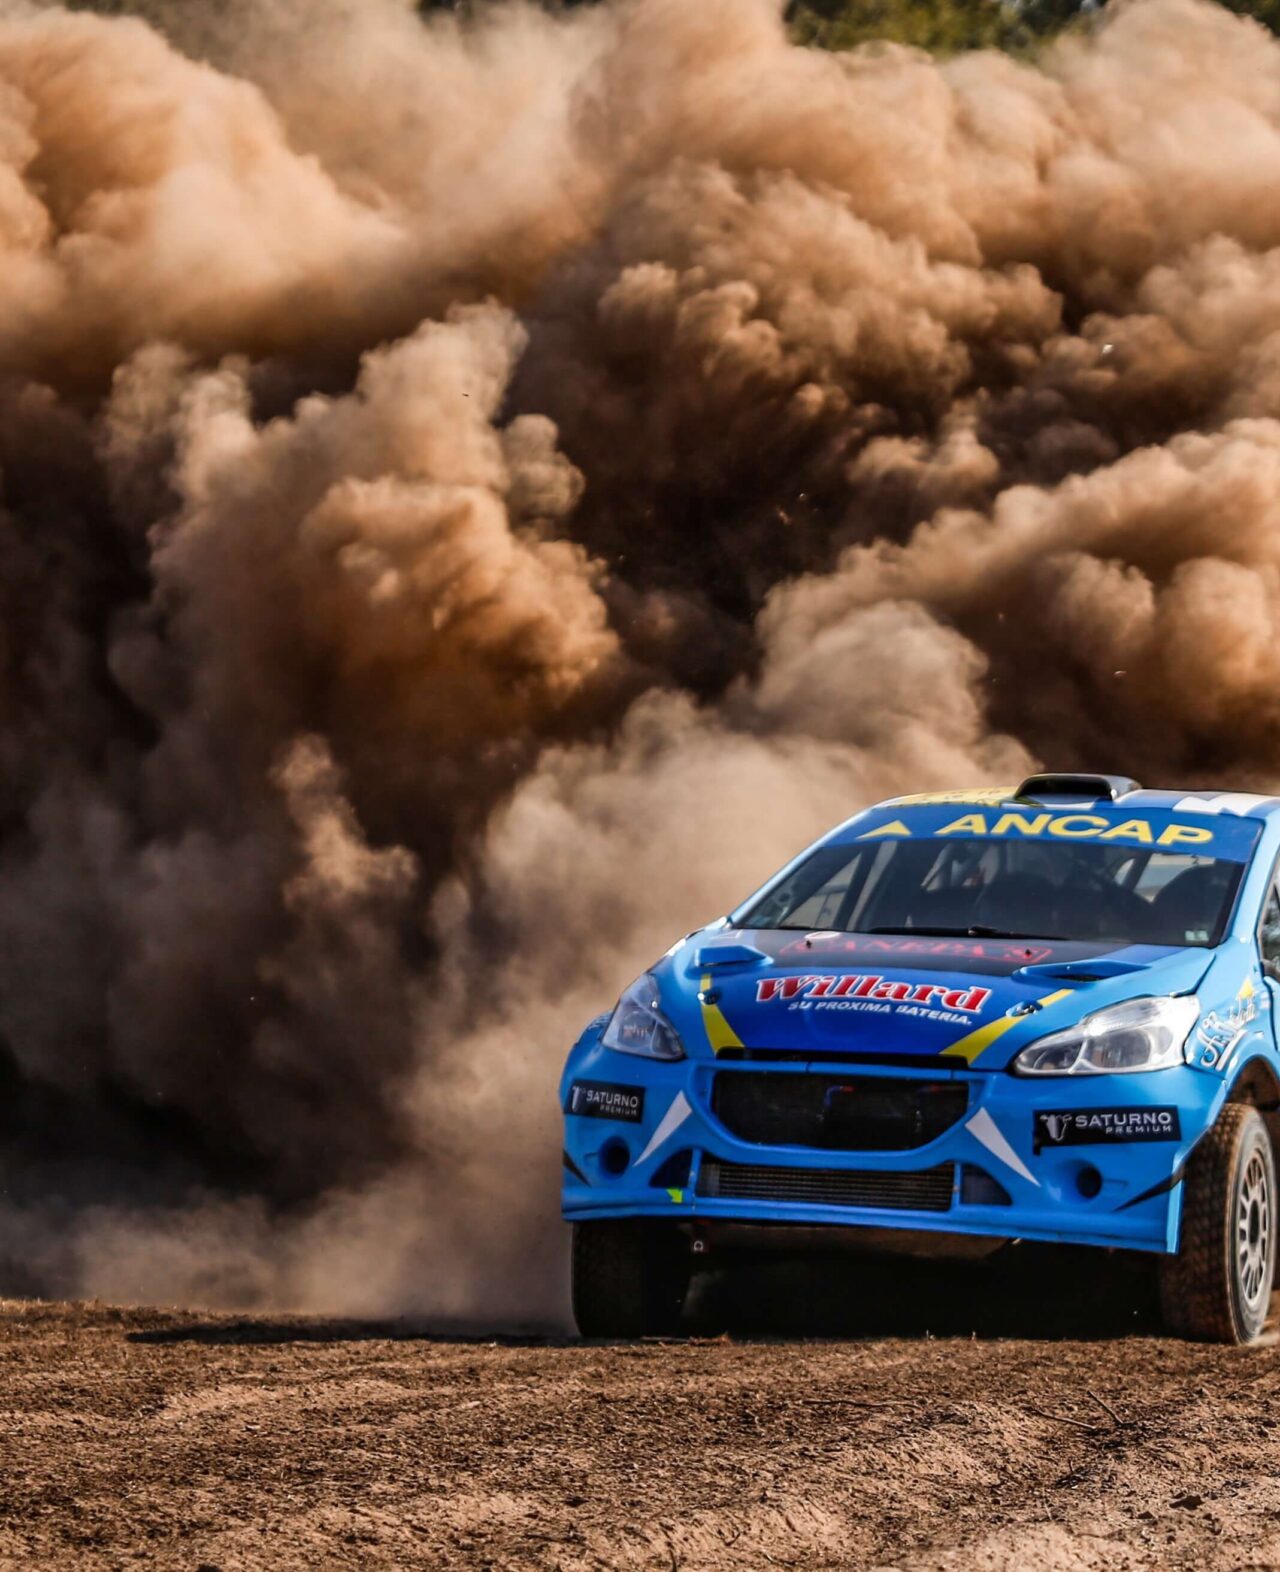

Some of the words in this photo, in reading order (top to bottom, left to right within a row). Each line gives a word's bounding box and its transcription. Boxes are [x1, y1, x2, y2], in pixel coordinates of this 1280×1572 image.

[933, 813, 1213, 845] ANCAP
[756, 974, 992, 1014] Willard
[788, 1001, 812, 1011] SU
[815, 1001, 891, 1013] PROXIMA
[895, 1004, 973, 1025] BATERIA.
[586, 1089, 639, 1108] SATURNO
[600, 1104, 637, 1116] PREMIUM
[1075, 1111, 1172, 1128] SATURNO
[1105, 1124, 1172, 1135] PREMIUM
